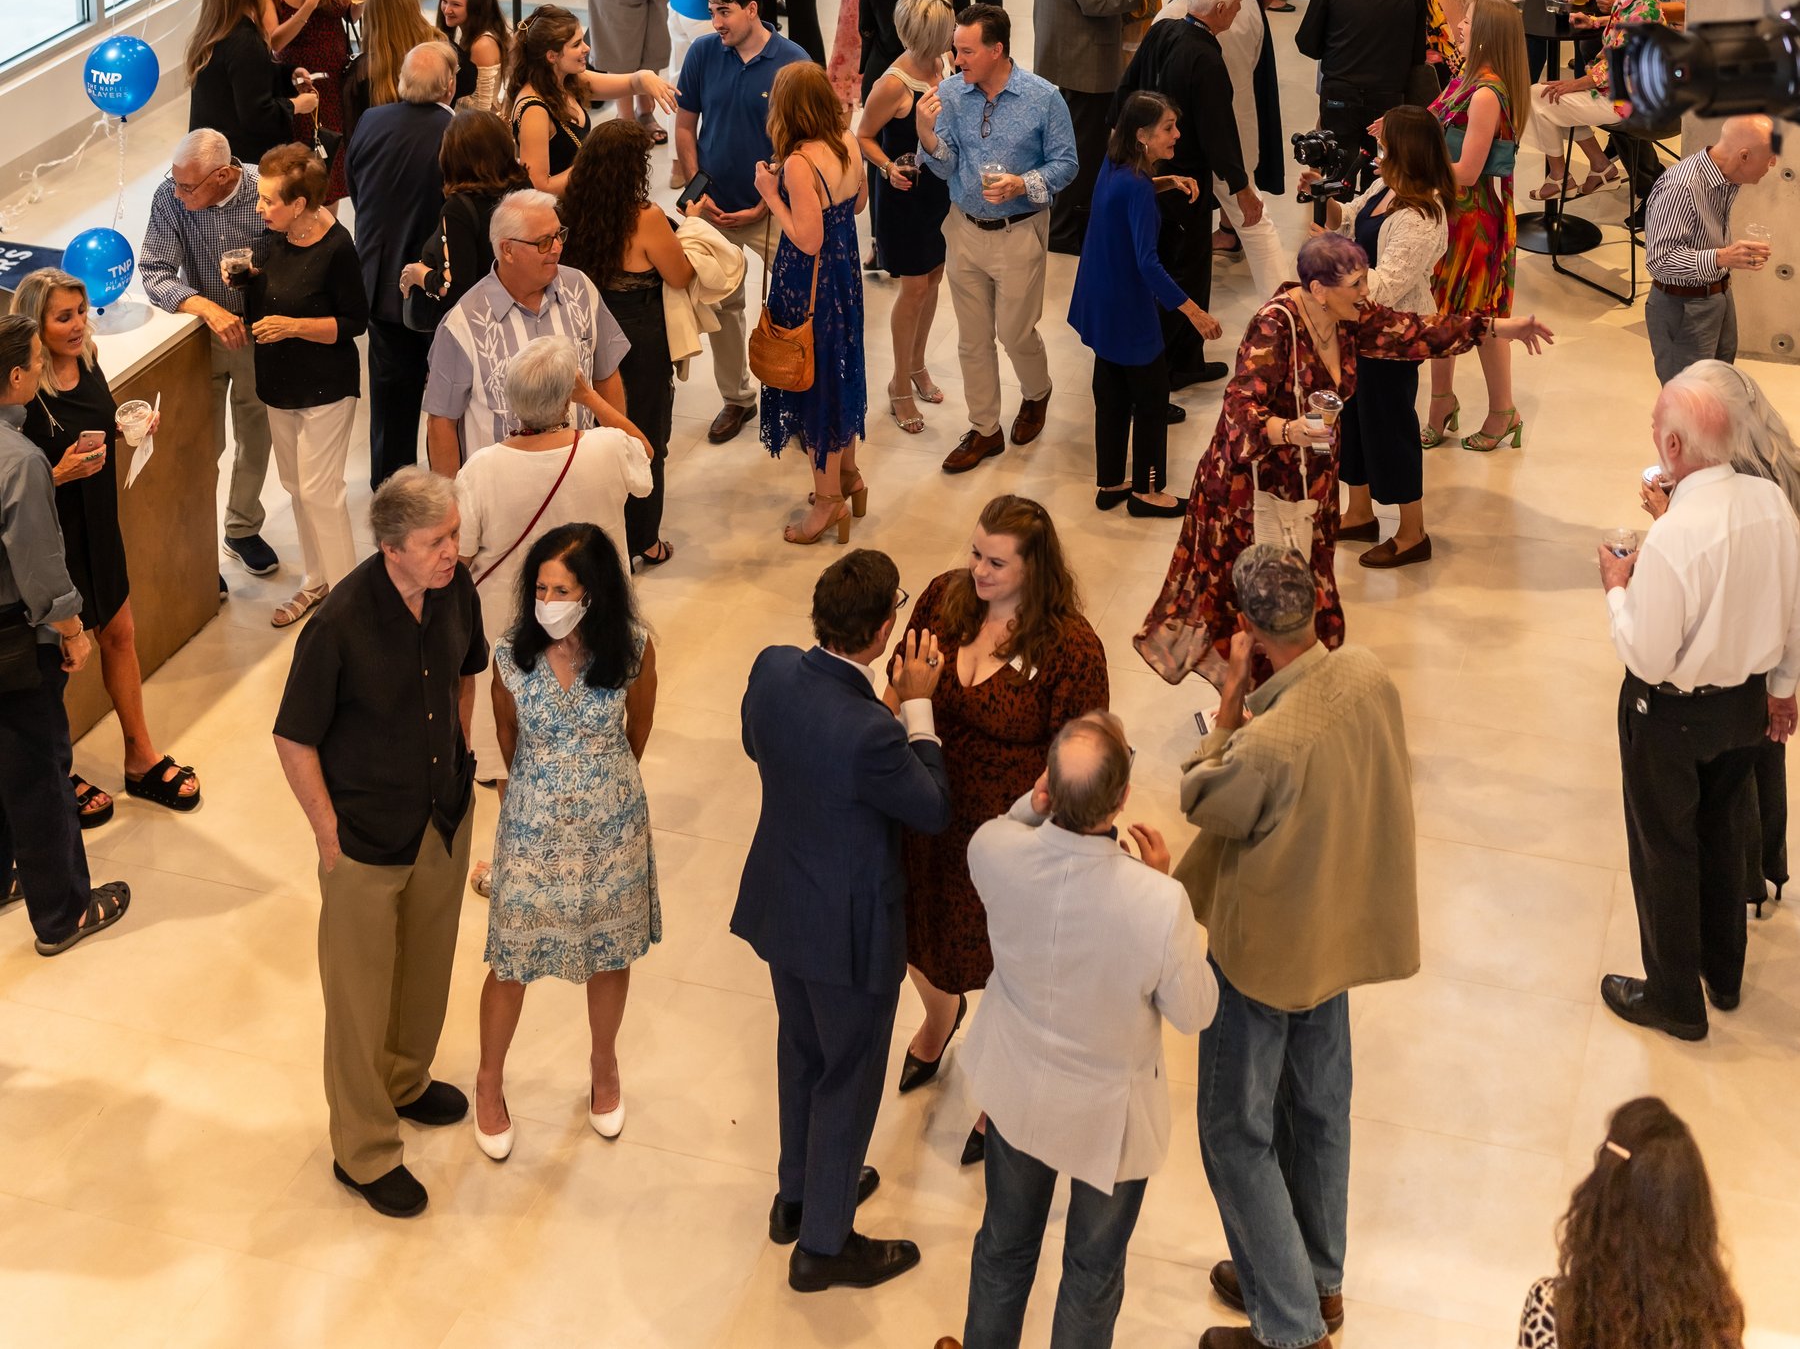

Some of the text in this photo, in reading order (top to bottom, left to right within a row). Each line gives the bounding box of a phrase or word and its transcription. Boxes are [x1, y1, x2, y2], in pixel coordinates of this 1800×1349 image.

[90, 69, 122, 85] TNP
[87, 82, 97, 91] THE
[88, 88, 129, 99] PLAYERS
[107, 258, 132, 278] TNP
